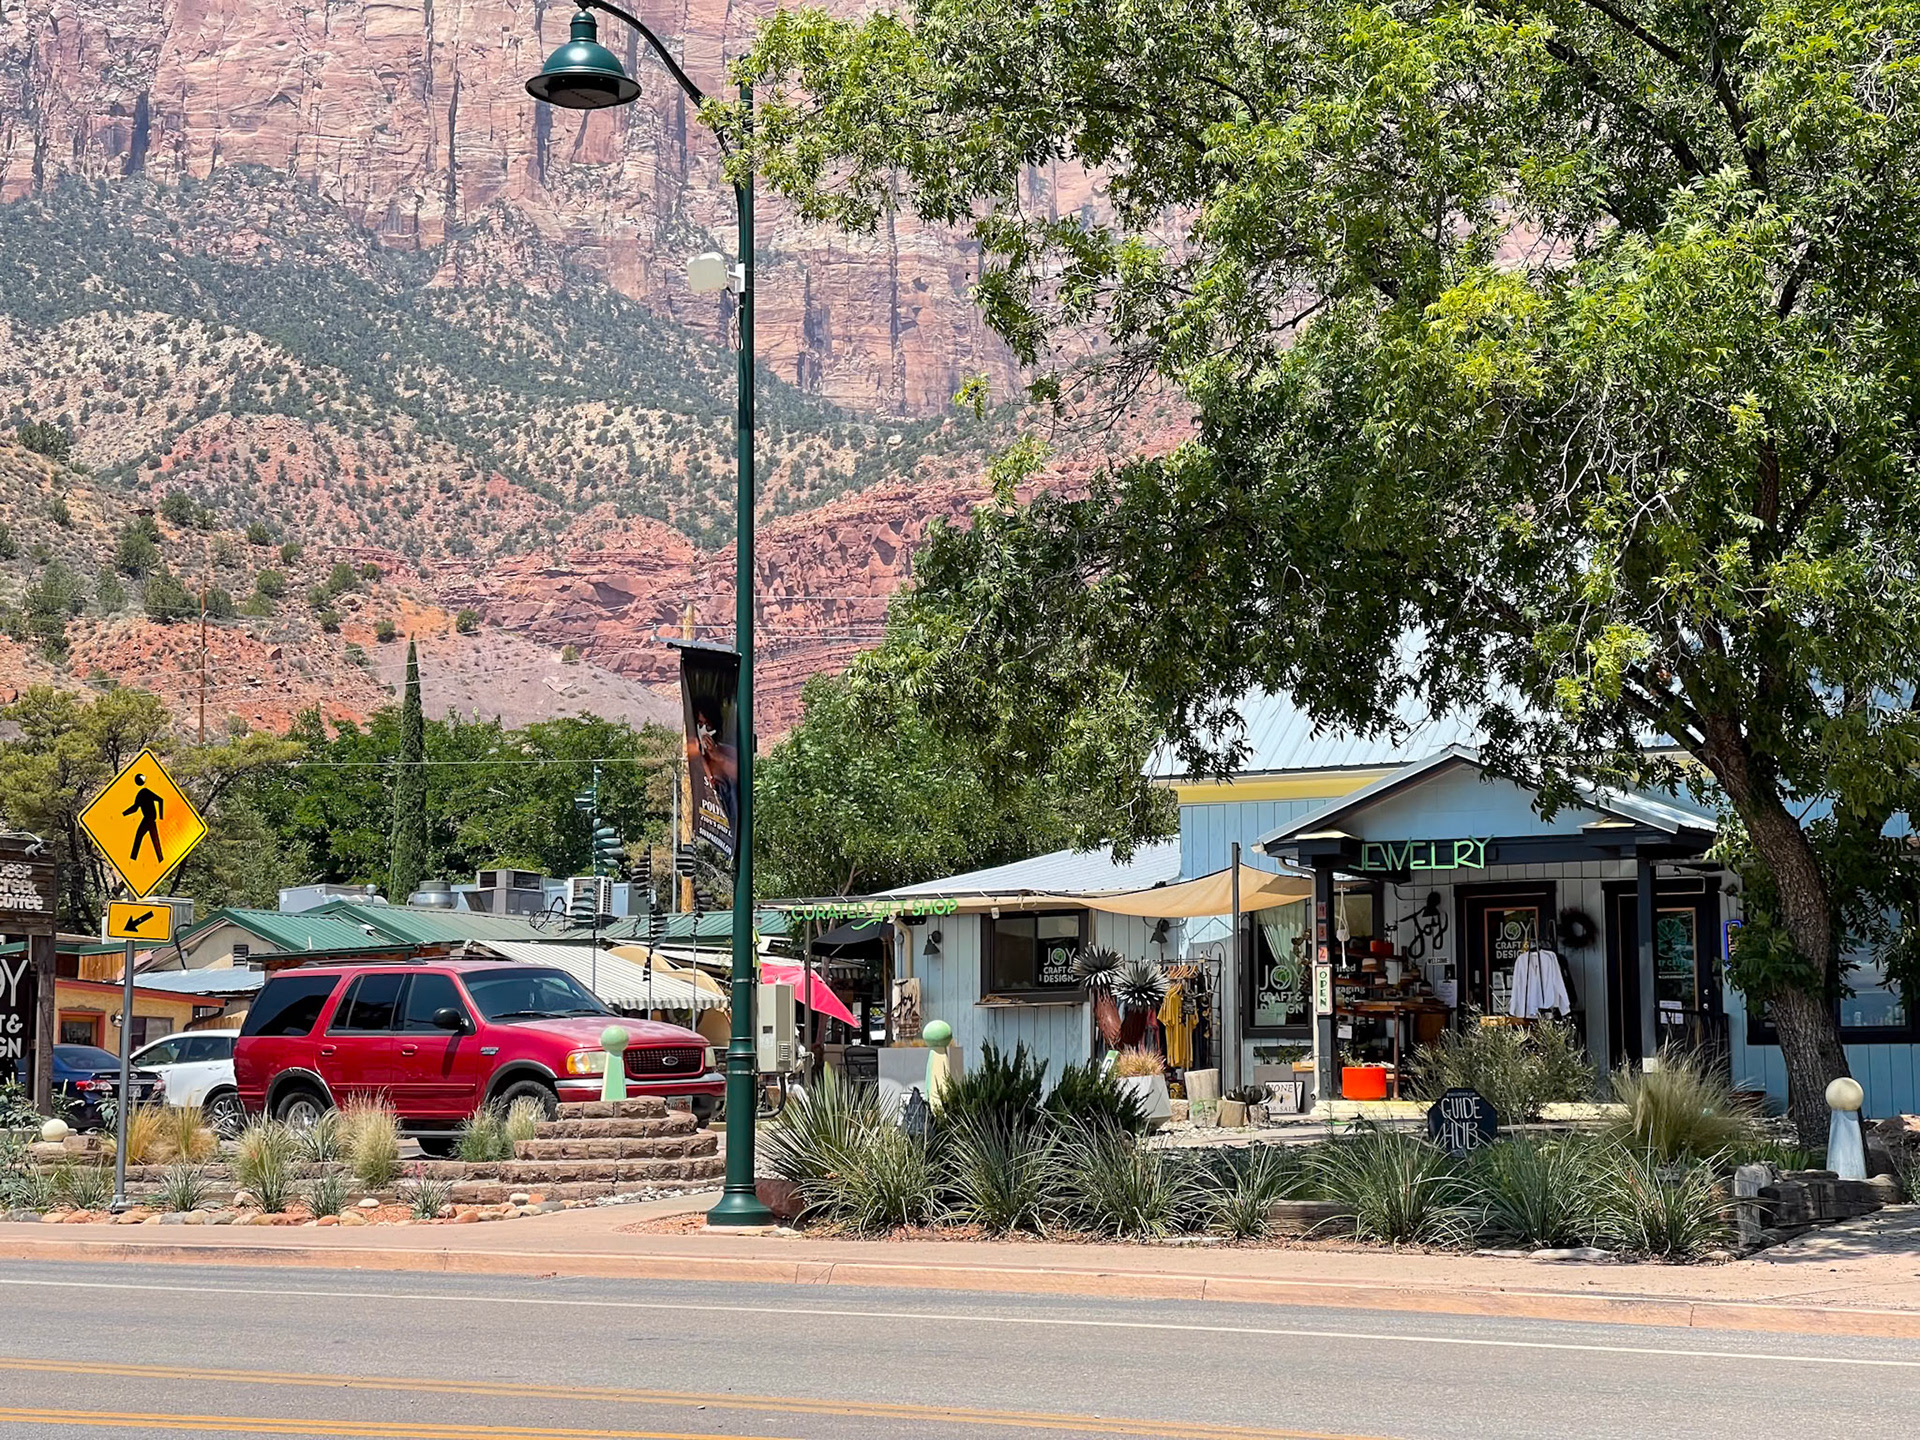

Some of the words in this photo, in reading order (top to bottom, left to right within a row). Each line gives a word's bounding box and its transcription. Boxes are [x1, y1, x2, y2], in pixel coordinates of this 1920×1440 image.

[1348, 835, 1494, 871] JEWELRY
[791, 904, 867, 921] CURATED
[872, 900, 906, 920] GIFT
[911, 898, 958, 916] SHOP
[1496, 921, 1531, 941] JOY
[1495, 941, 1521, 950] CRAFT
[1043, 947, 1076, 965] JOY
[1043, 966, 1067, 974] CRAFT
[1044, 974, 1074, 983] DESIGN
[1259, 965, 1307, 990] JOY
[1259, 991, 1293, 1002] CRAFT
[1295, 991, 1304, 1002] &
[1319, 971, 1328, 1007] OPEN
[6, 1014, 23, 1033] &
[1441, 1097, 1483, 1119] GUIDE
[1443, 1121, 1481, 1150] HUB
